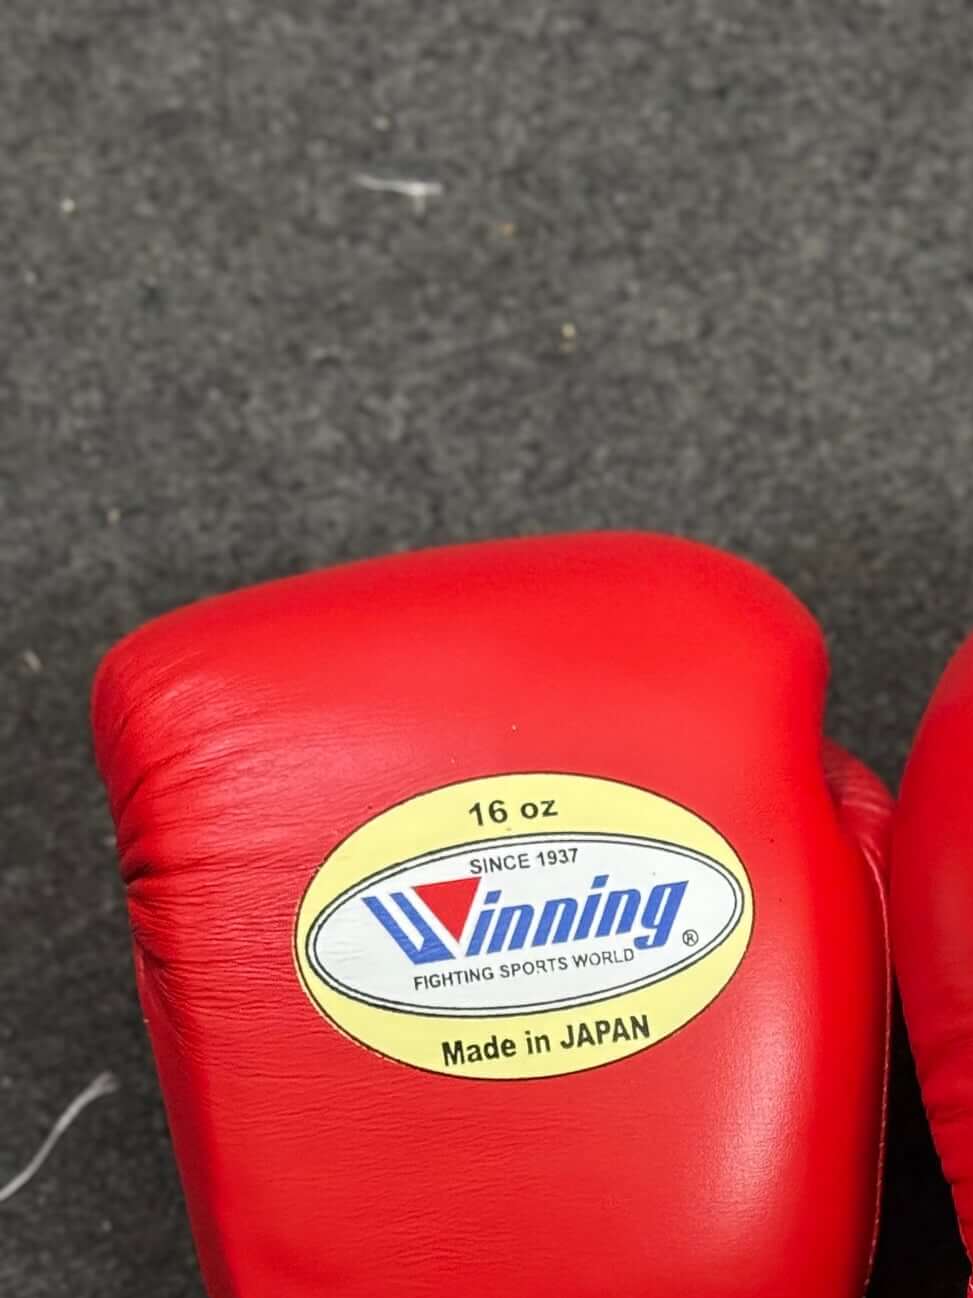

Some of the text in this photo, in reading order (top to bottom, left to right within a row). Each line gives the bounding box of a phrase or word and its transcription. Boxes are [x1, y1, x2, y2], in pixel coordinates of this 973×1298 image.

[468, 799, 558, 827] 16 oz
[470, 848, 579, 874] SINCE 1937
[362, 874, 689, 966] Winning
[413, 948, 635, 991] FIGHTING SPORTS WORLD
[442, 1014, 651, 1066] Made in JAPAN
